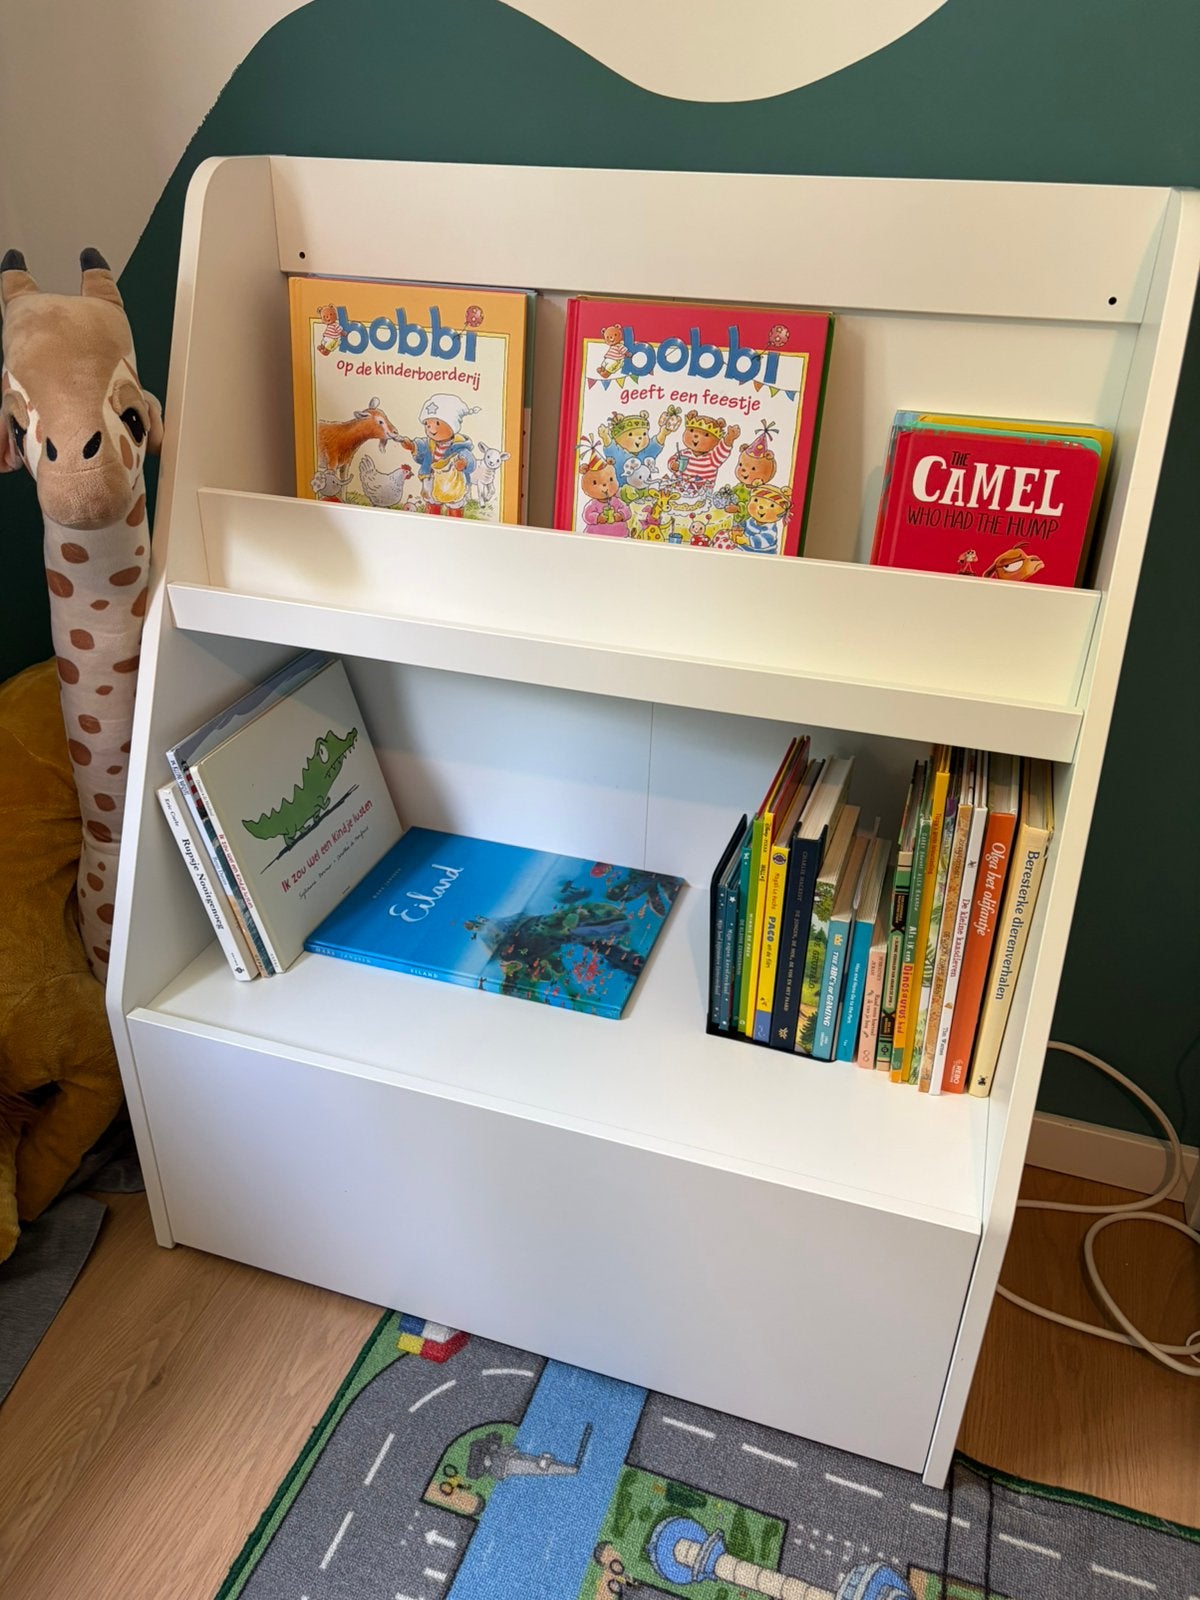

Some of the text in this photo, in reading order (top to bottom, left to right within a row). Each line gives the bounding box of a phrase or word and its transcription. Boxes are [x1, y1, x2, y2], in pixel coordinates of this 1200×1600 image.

[337, 306, 477, 362] bobbi
[621, 325, 780, 385] bobbi
[336, 360, 481, 391] op de kinderboerderij
[620, 384, 761, 416] geeft een feestje
[951, 451, 970, 467] THE
[912, 455, 1065, 517] CAMEL
[907, 505, 1059, 541] WHO HAD THE HUMP
[163, 797, 181, 827] Eric Carle
[291, 866, 306, 884] zou
[307, 850, 320, 868] wel
[320, 840, 333, 855] een
[352, 800, 373, 823] lusten
[182, 838, 225, 930] Rupsje Nooitgenoeg
[389, 863, 465, 923] Eiland
[976, 842, 1006, 936] Olga het olifantje
[766, 916, 775, 942] PACO
[908, 926, 917, 939] Als
[951, 898, 969, 977] De kleine kaasdieven
[995, 851, 1039, 1001] Beresterke dierenverhalen
[410, 968, 438, 978] EILAND
[808, 937, 821, 989] DE GRUFFALO
[823, 994, 833, 1026] GAMING
[898, 965, 912, 1019] Dinosaurus
[896, 1021, 906, 1034] had
[952, 1064, 962, 1084] REBO
